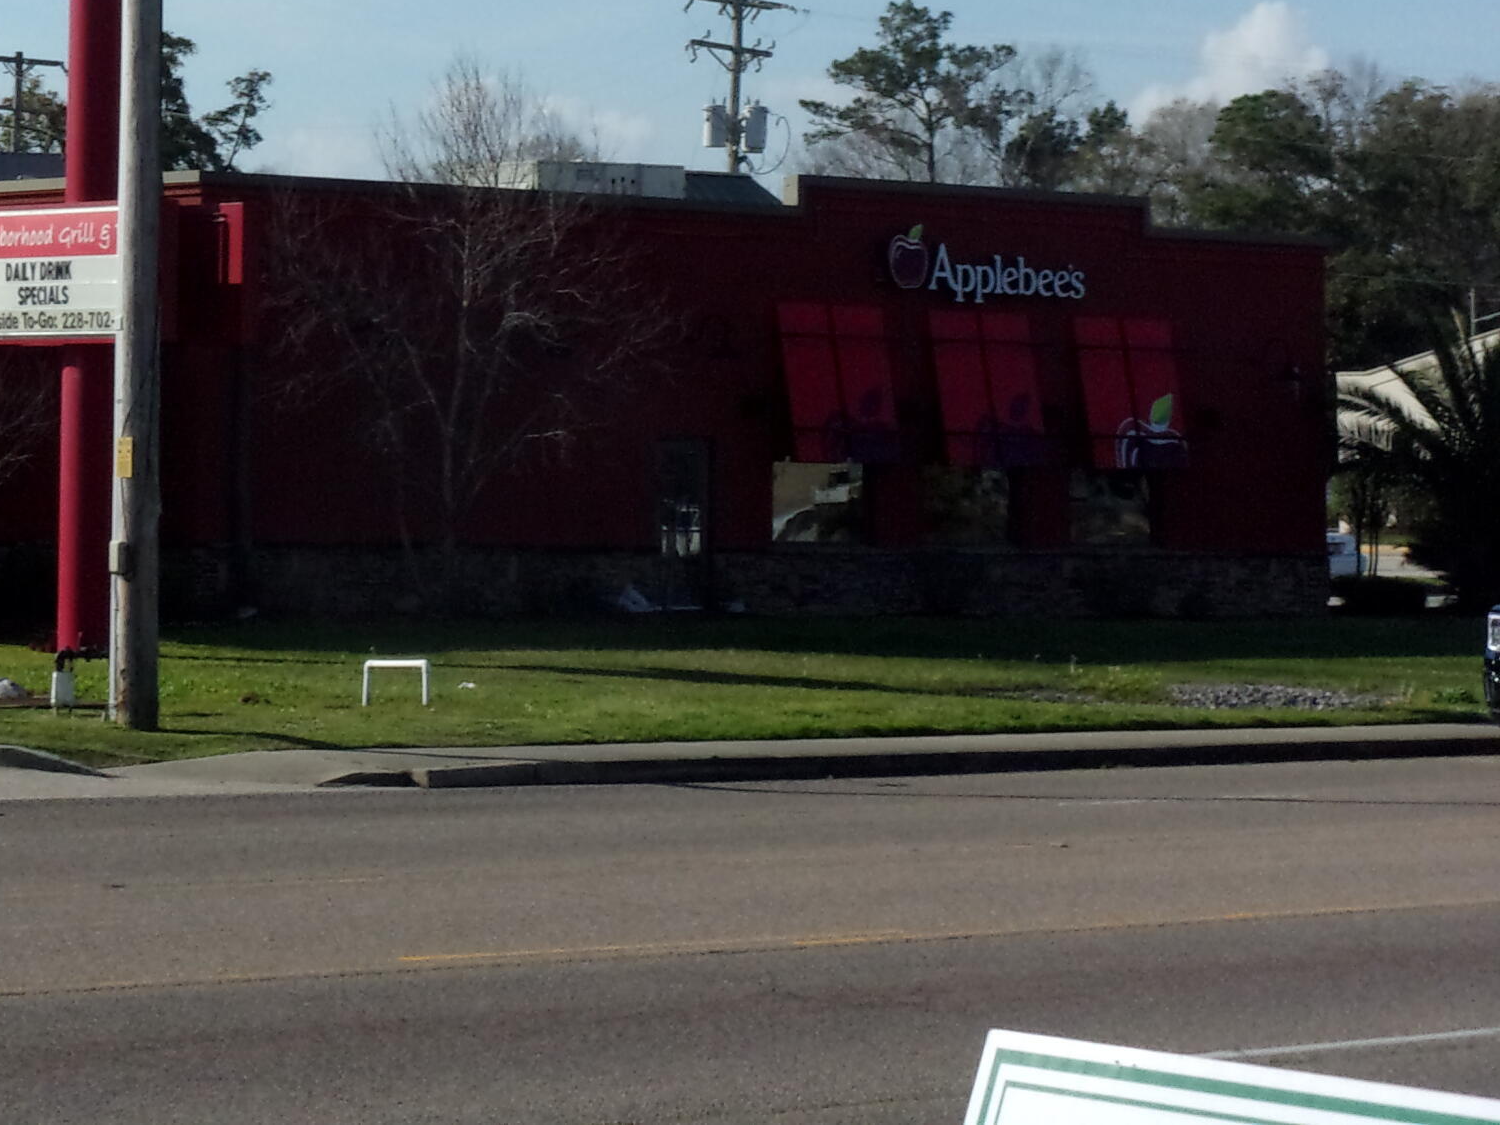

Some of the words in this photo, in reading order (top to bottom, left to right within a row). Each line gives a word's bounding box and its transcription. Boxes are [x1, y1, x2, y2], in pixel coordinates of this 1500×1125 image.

[58, 222, 95, 248] Grill
[99, 224, 111, 249] &
[5, 262, 36, 281] DAILY
[40, 261, 72, 280] DRINK
[928, 243, 1086, 303] Applebee's
[18, 286, 69, 305] SPECIALS
[22, 312, 57, 329] To-Go:
